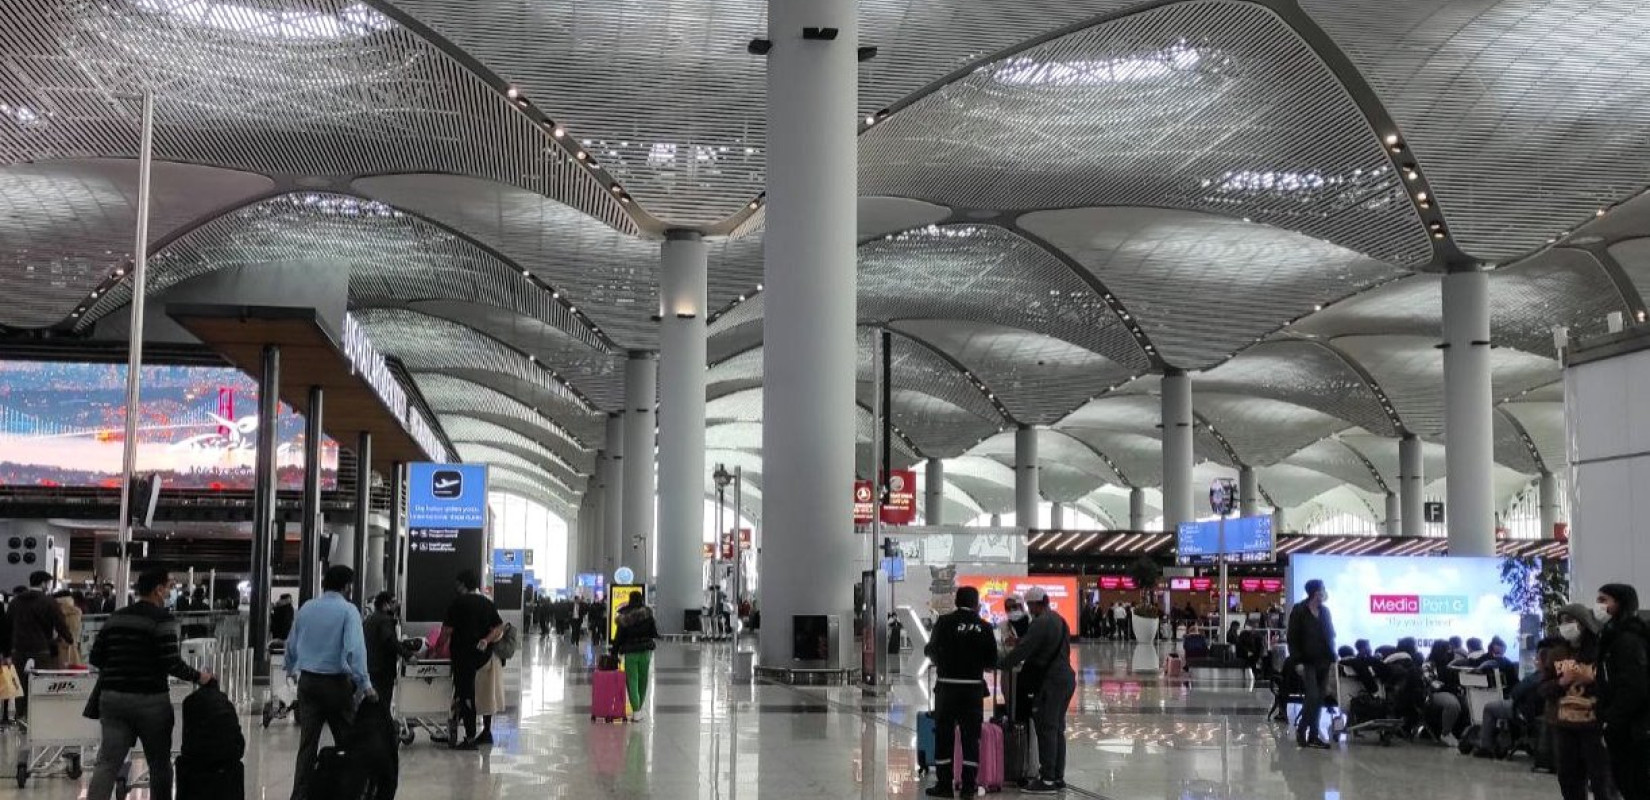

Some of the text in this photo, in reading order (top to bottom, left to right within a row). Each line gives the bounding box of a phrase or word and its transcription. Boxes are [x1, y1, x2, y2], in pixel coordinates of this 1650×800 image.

[1430, 504, 1440, 521] F
[1372, 597, 1418, 611] Media
[1422, 597, 1449, 611] Port
